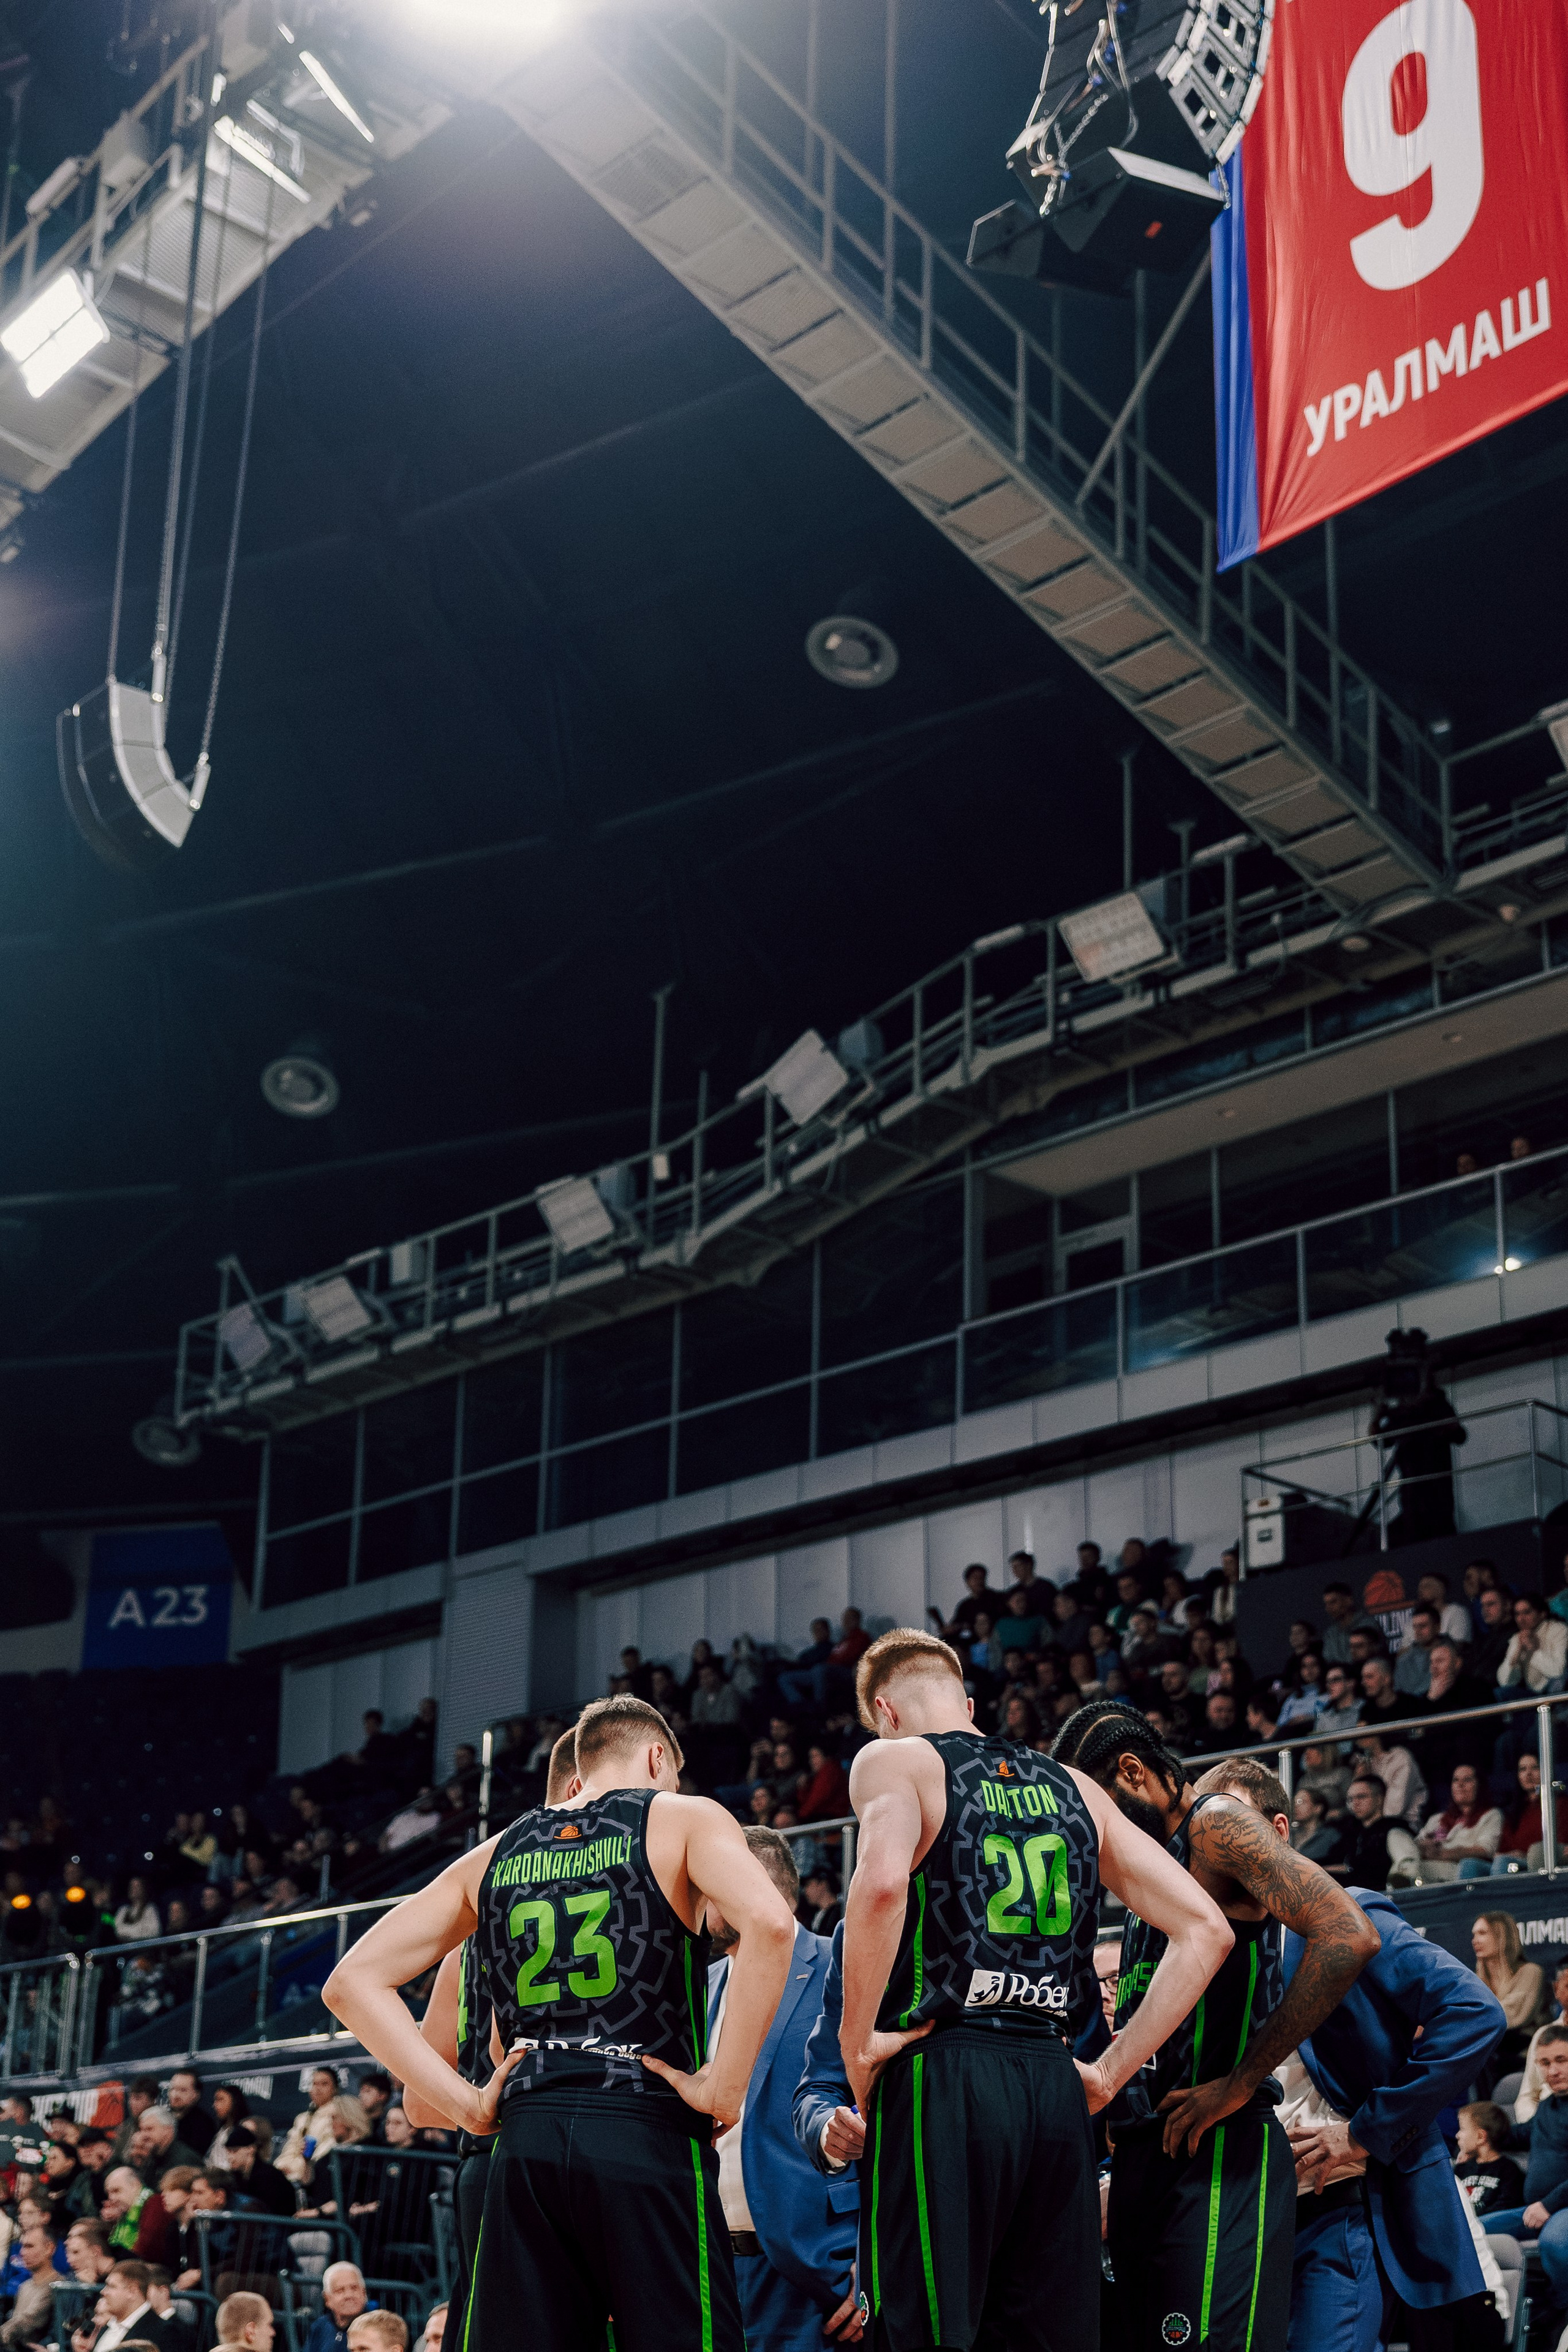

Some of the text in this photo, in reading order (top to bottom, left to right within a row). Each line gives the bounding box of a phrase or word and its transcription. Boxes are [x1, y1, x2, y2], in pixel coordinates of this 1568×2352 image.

[1342, 0, 1485, 291] 9
[1303, 277, 1552, 457] УРАЛМАШ
[491, 1836, 632, 1888] KARDANAKHISHVILI
[982, 1833, 1072, 1936] 20
[509, 1890, 617, 2007] 23
